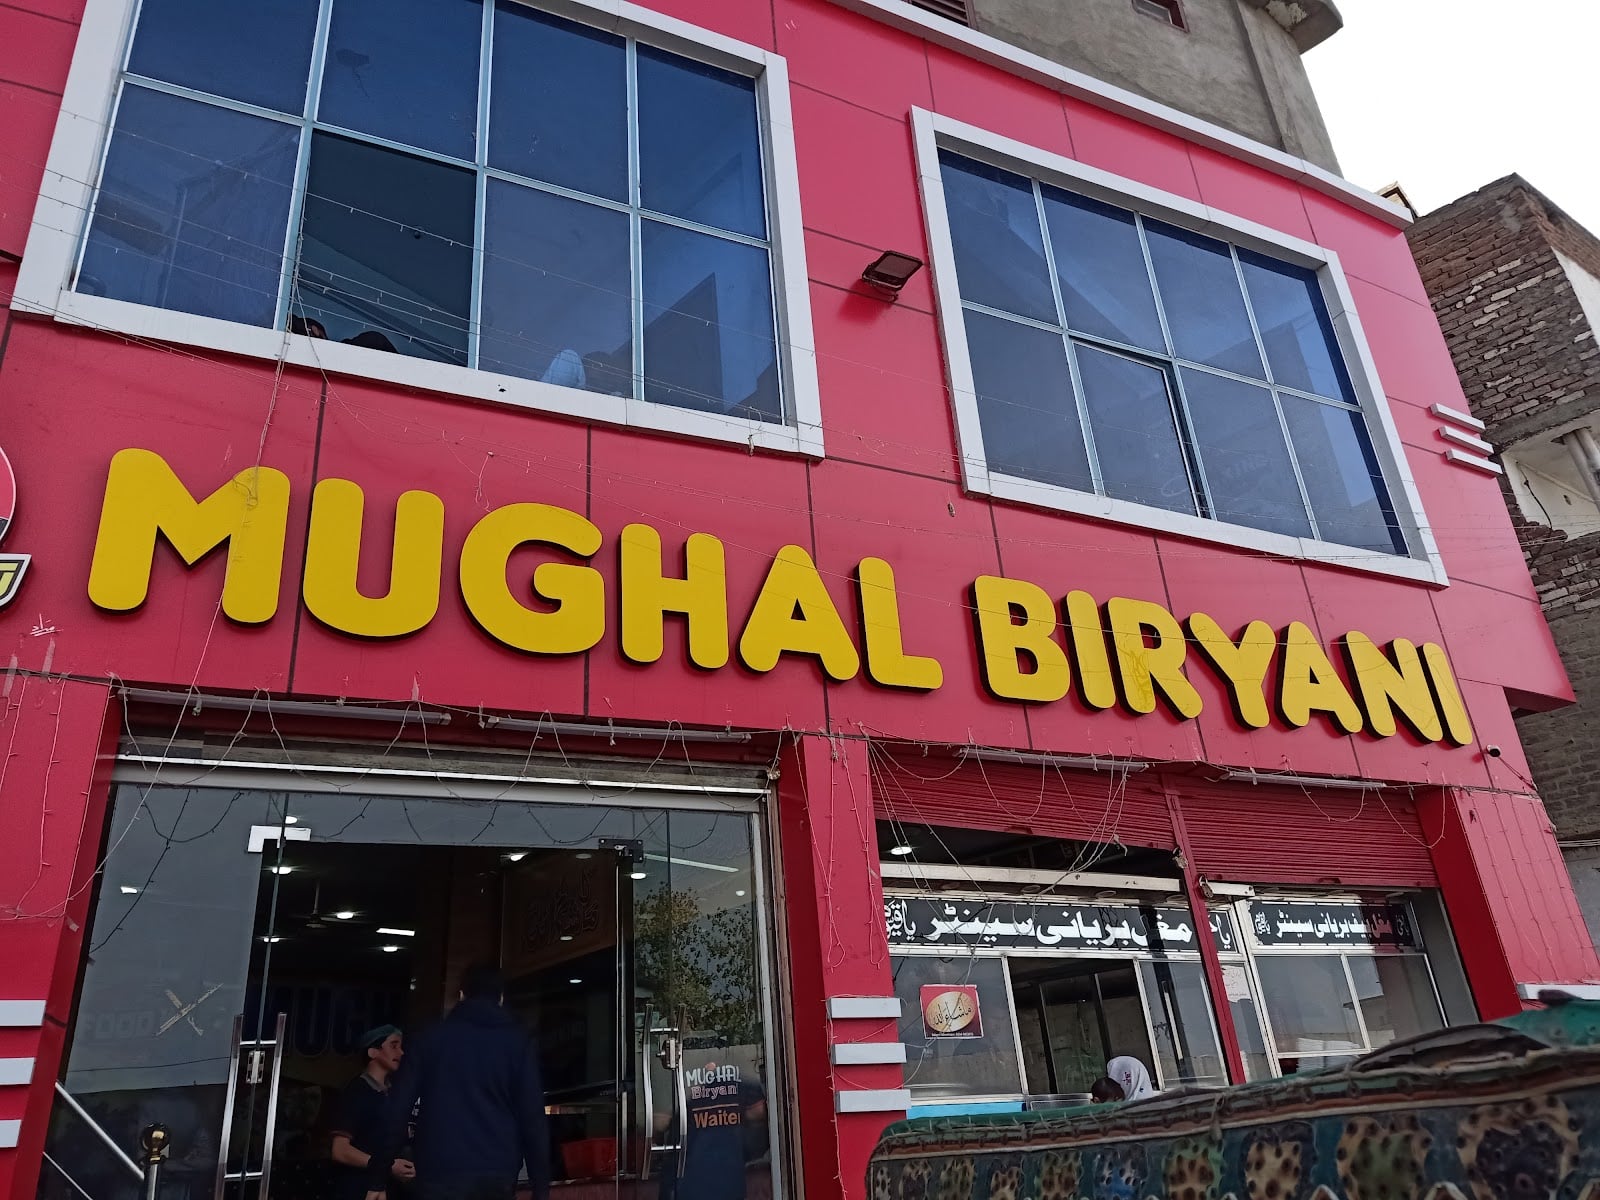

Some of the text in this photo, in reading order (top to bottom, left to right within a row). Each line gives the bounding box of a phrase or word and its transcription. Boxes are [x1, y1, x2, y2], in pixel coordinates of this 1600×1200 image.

[90, 449, 1470, 742] MUGHAL BIRYANI
[685, 1064, 742, 1087] MUGHAL
